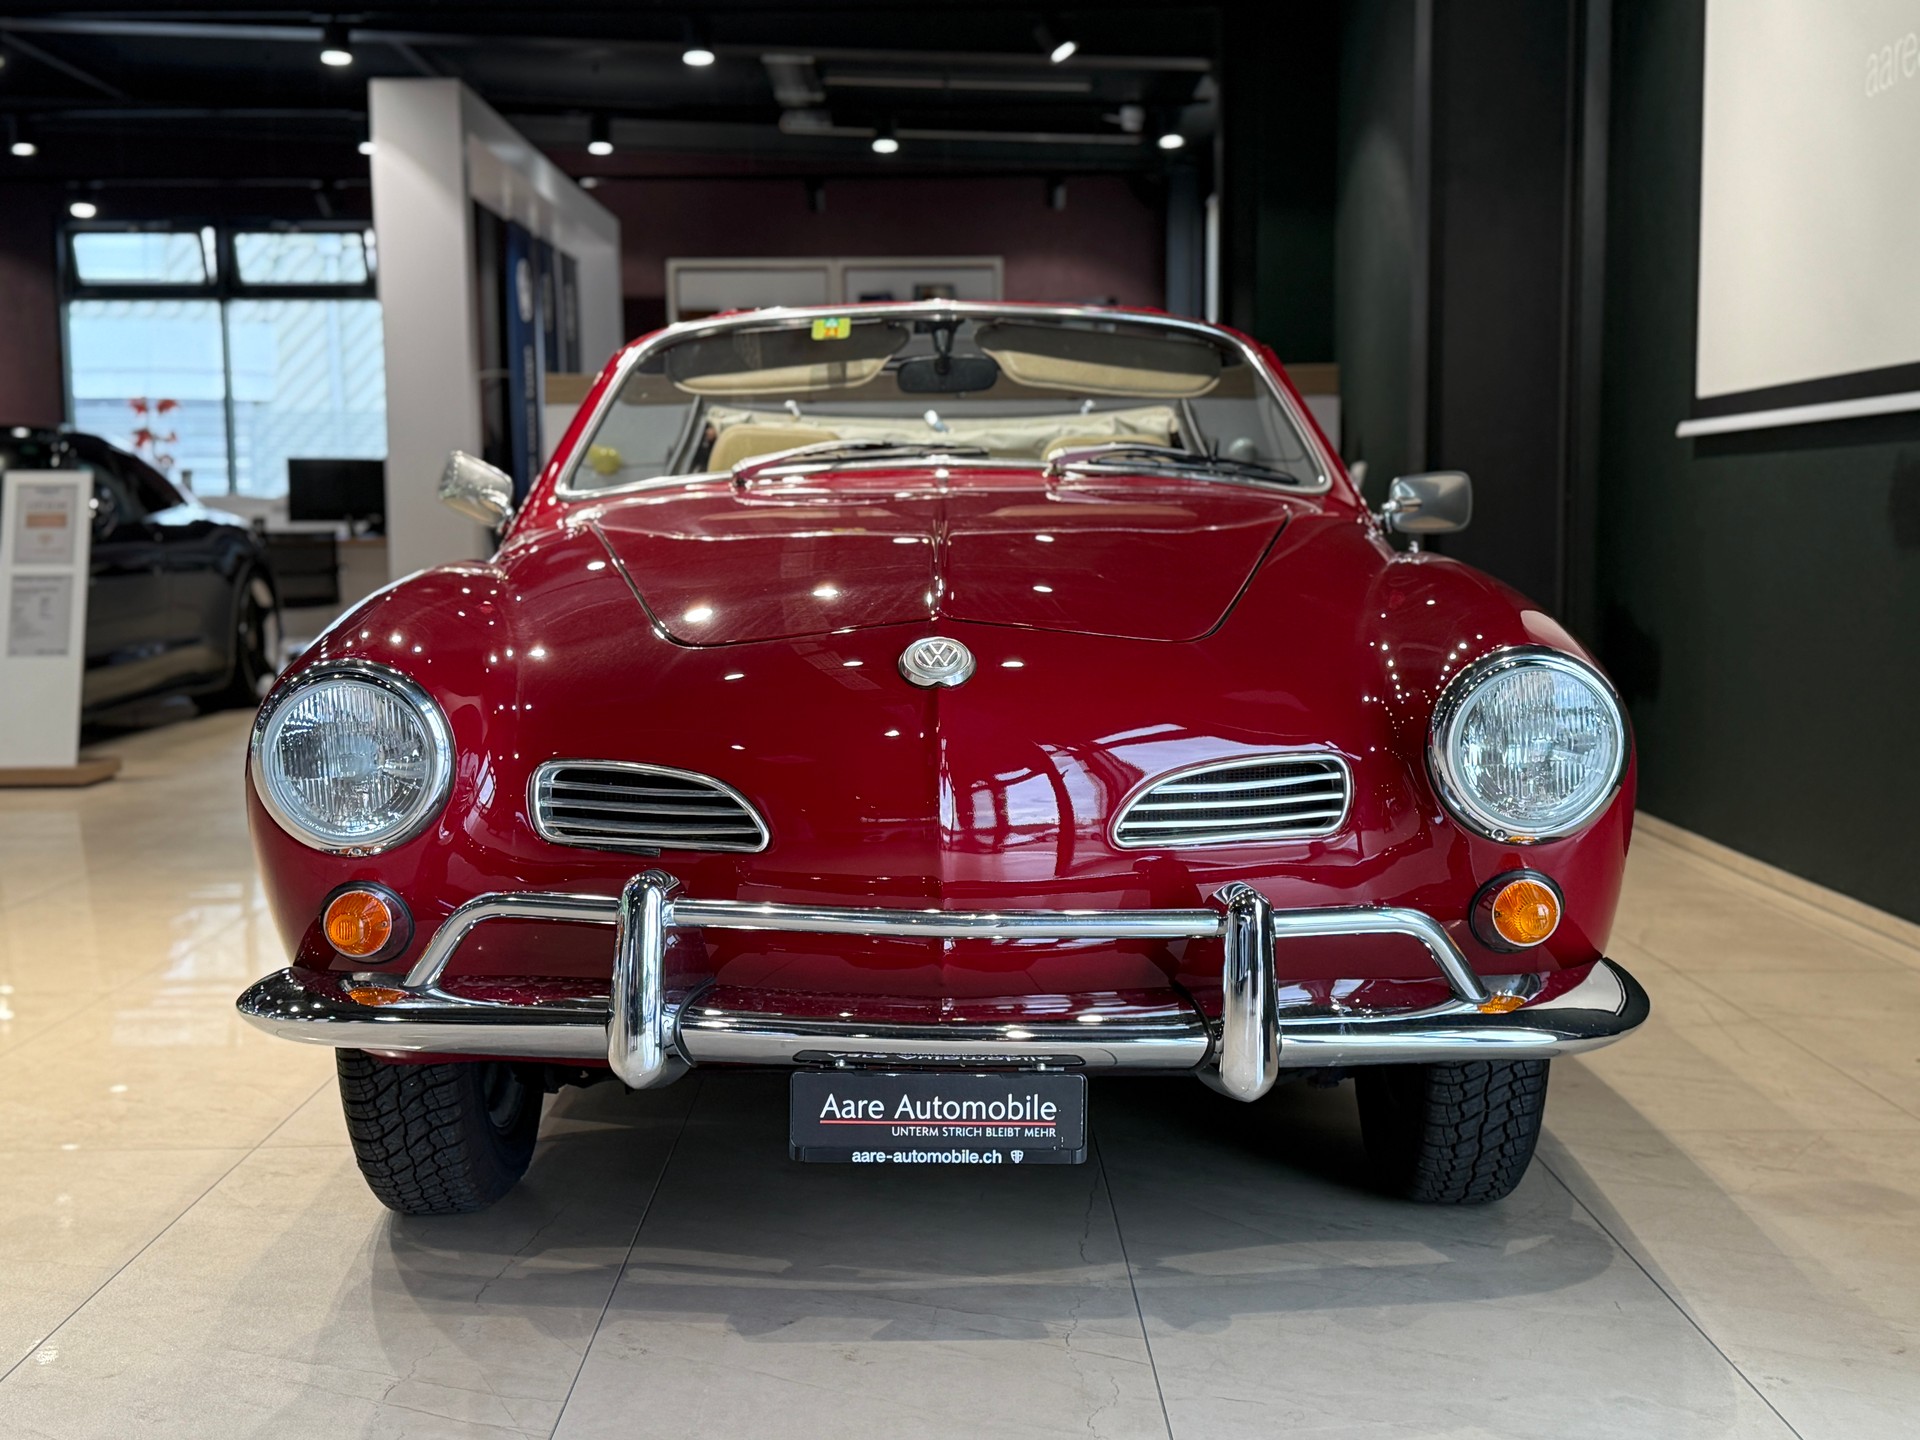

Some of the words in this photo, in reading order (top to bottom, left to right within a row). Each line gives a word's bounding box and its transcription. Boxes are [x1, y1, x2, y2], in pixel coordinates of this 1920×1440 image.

[1865, 32, 1920, 97] aare
[916, 640, 961, 669] VW
[819, 1092, 885, 1119] Aare
[893, 1093, 1058, 1121] Automobile
[891, 1126, 939, 1137] UNTERM
[942, 1126, 983, 1138] STRICH
[985, 1126, 1022, 1138] BLEIBT
[1024, 1127, 1057, 1138] MEHR
[851, 1148, 1003, 1164] aare-automobile.ch
